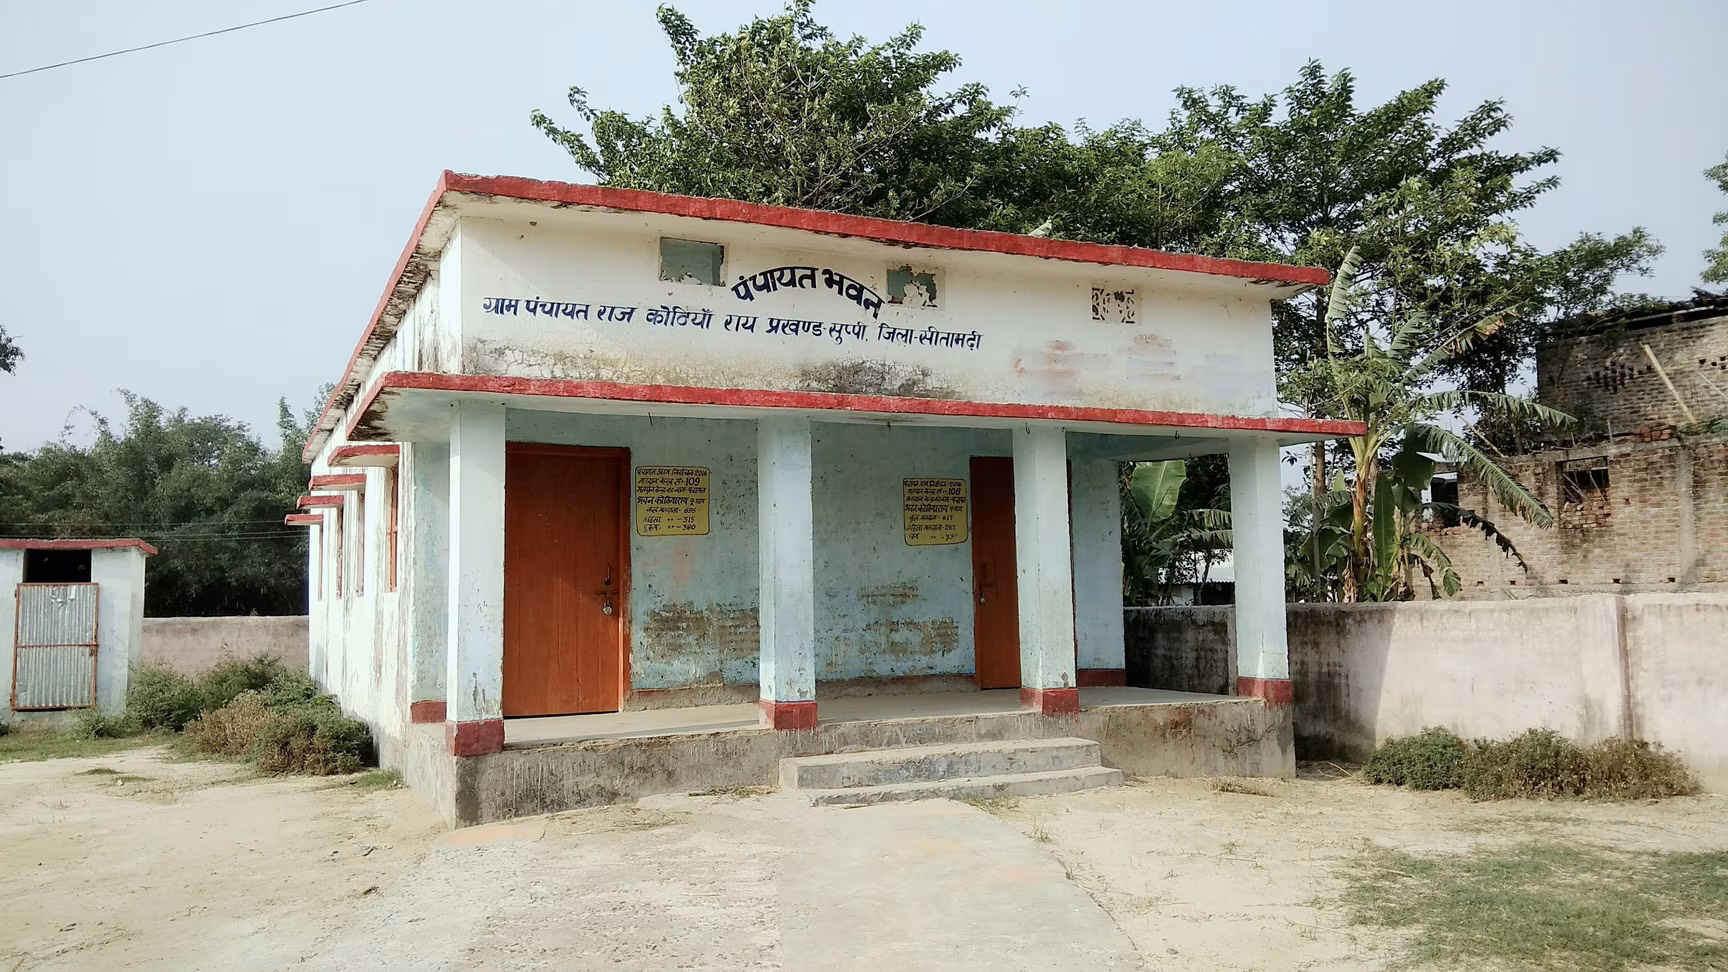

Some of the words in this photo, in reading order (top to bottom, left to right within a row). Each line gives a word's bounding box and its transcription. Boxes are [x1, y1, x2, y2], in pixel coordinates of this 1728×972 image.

[731, 266, 819, 302] पंचायत
[821, 267, 886, 319] भवन
[483, 297, 521, 317] ग्राम
[524, 296, 592, 321] पंचायत
[597, 305, 638, 324] राज
[724, 314, 759, 334] राय
[636, 496, 655, 504] भवन
